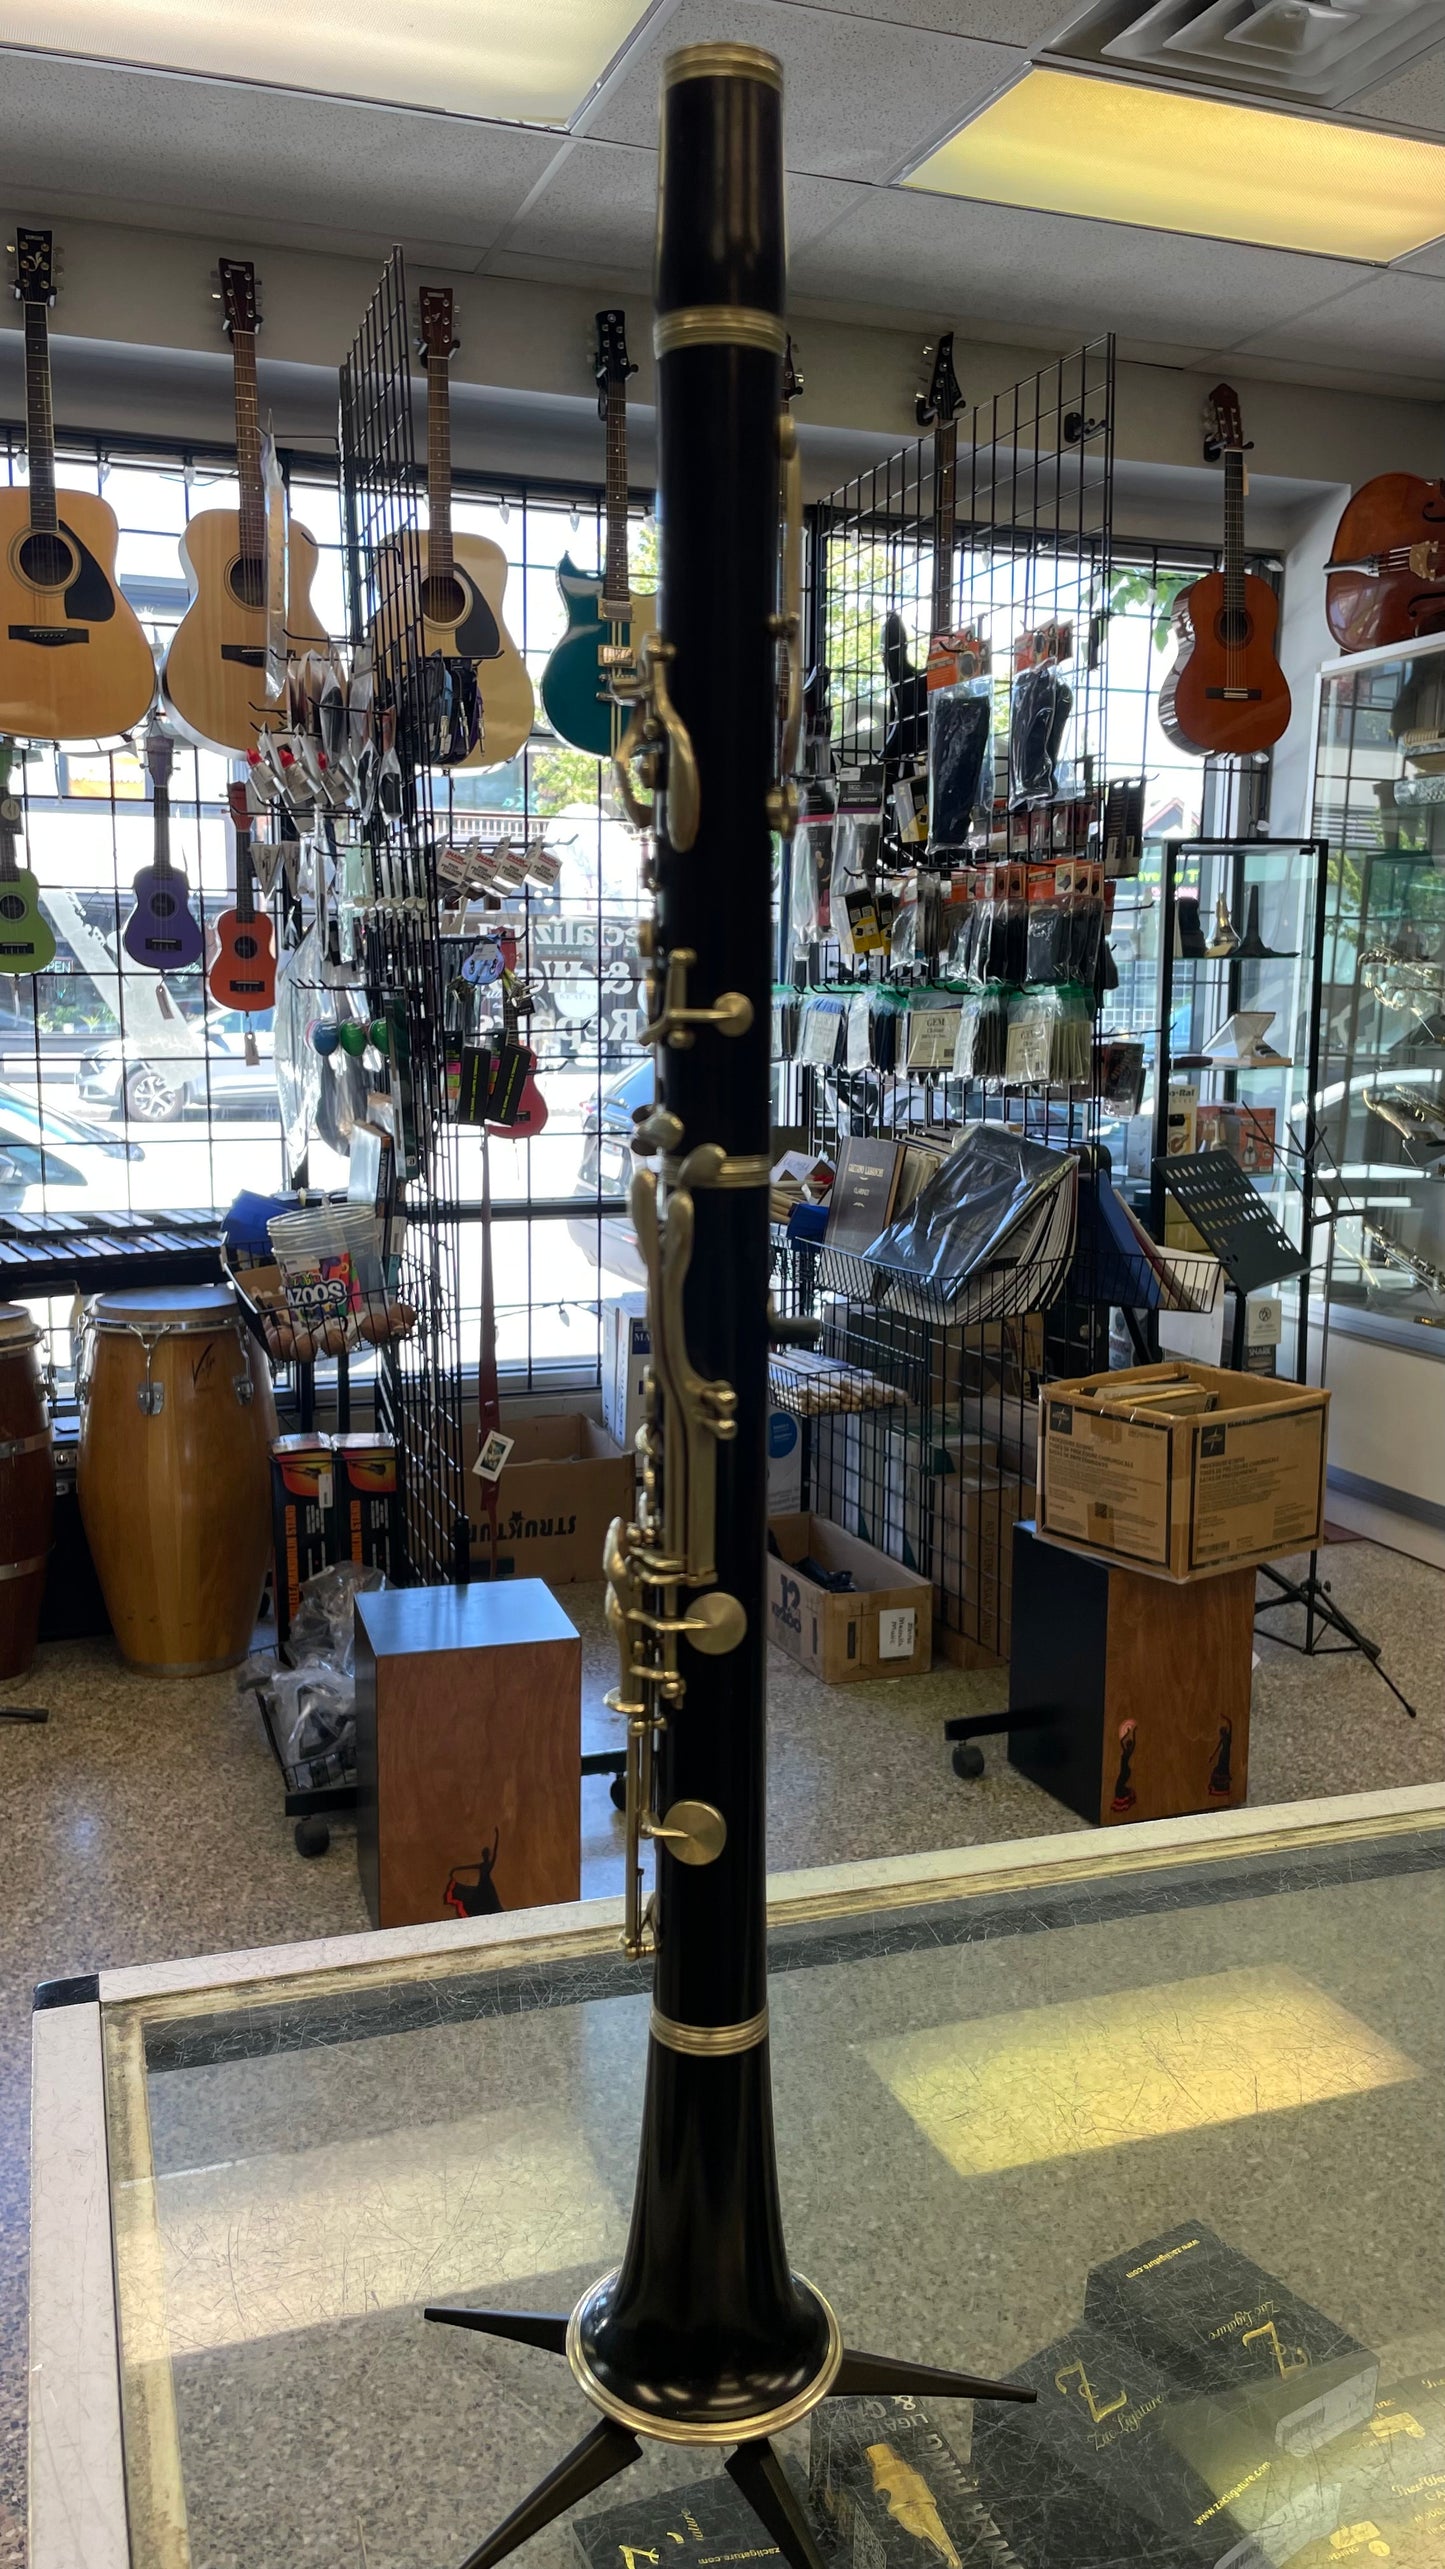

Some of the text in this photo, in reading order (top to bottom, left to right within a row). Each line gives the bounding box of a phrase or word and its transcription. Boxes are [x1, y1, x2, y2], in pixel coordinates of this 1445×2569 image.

[46, 960, 71, 974] PEN
[286, 1282, 345, 1306] AZOOS
[1125, 2238, 1201, 2279] www.zacligature.com
[1207, 2310, 1254, 2341] Ligature
[1193, 2460, 1272, 2527] www.zacligature.com
[697, 2546, 781, 2566] zacligature.com
